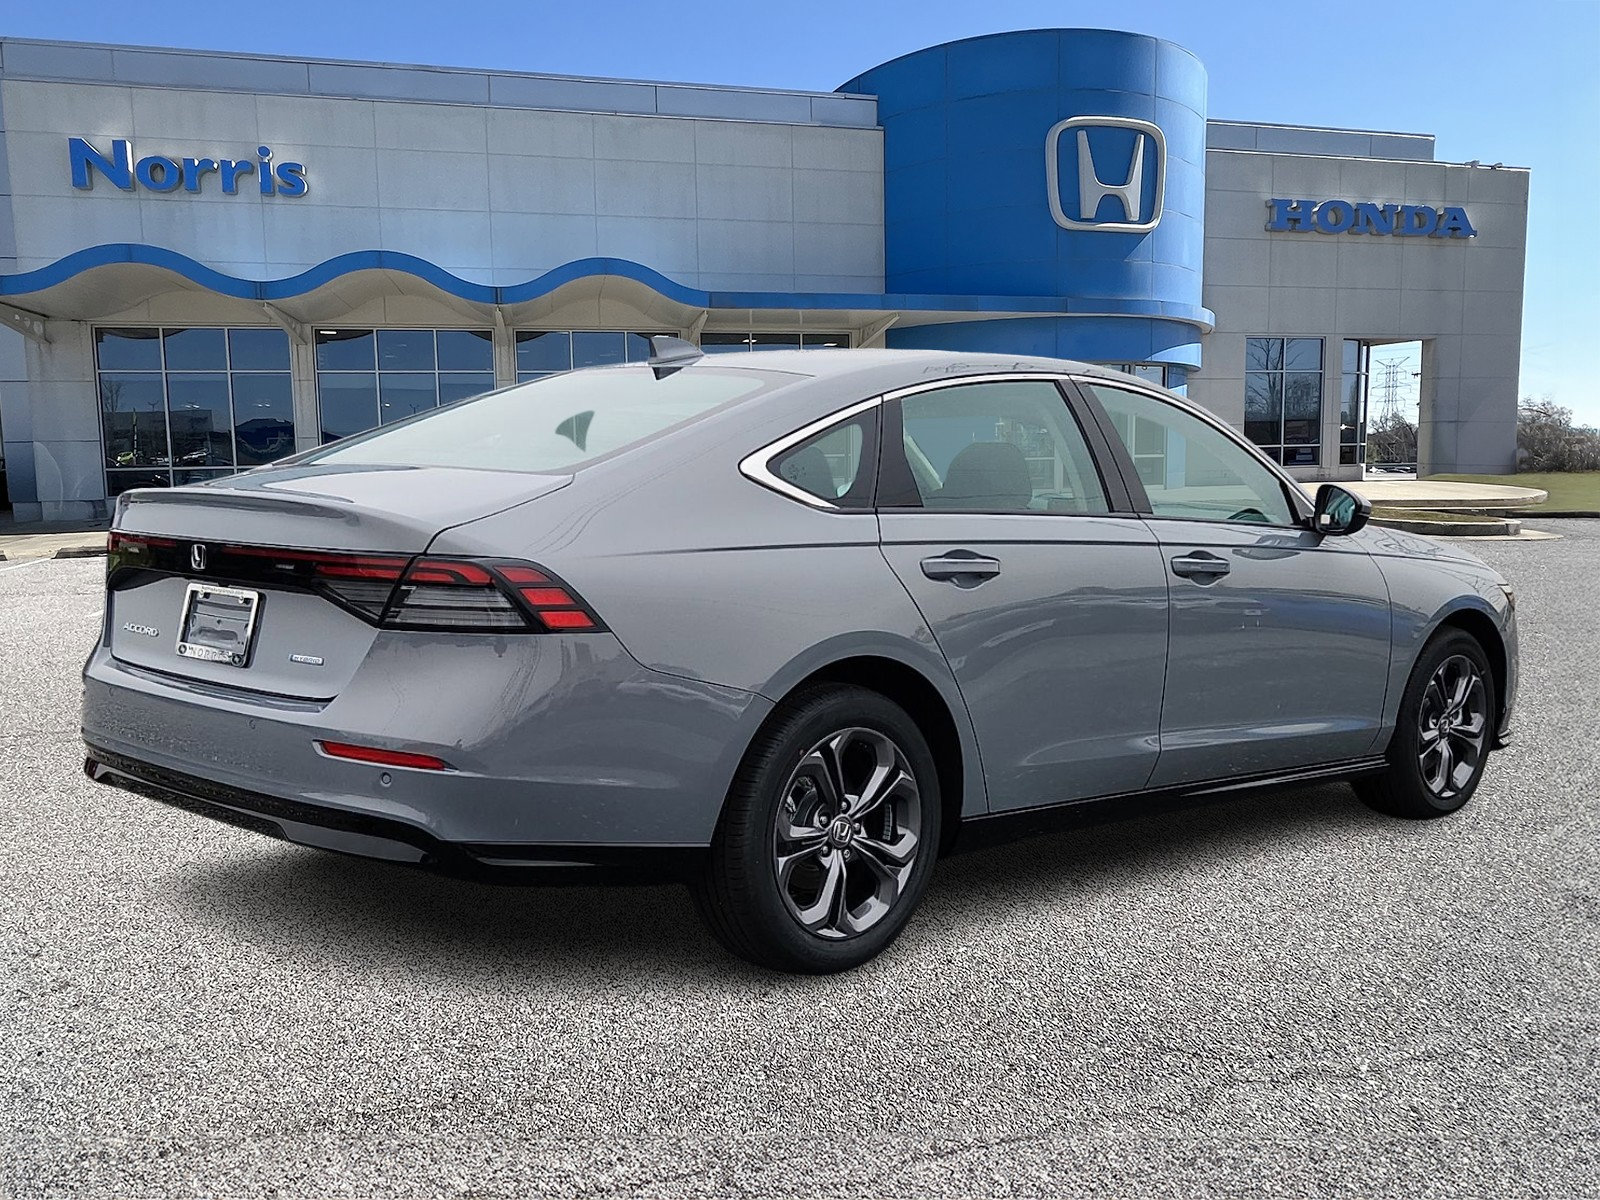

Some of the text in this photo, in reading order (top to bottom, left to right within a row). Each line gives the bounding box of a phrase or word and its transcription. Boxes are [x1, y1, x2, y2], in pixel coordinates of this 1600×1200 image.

[68, 137, 309, 197] Norris
[1265, 198, 1478, 239] HONDA
[122, 622, 160, 637] ACCORD
